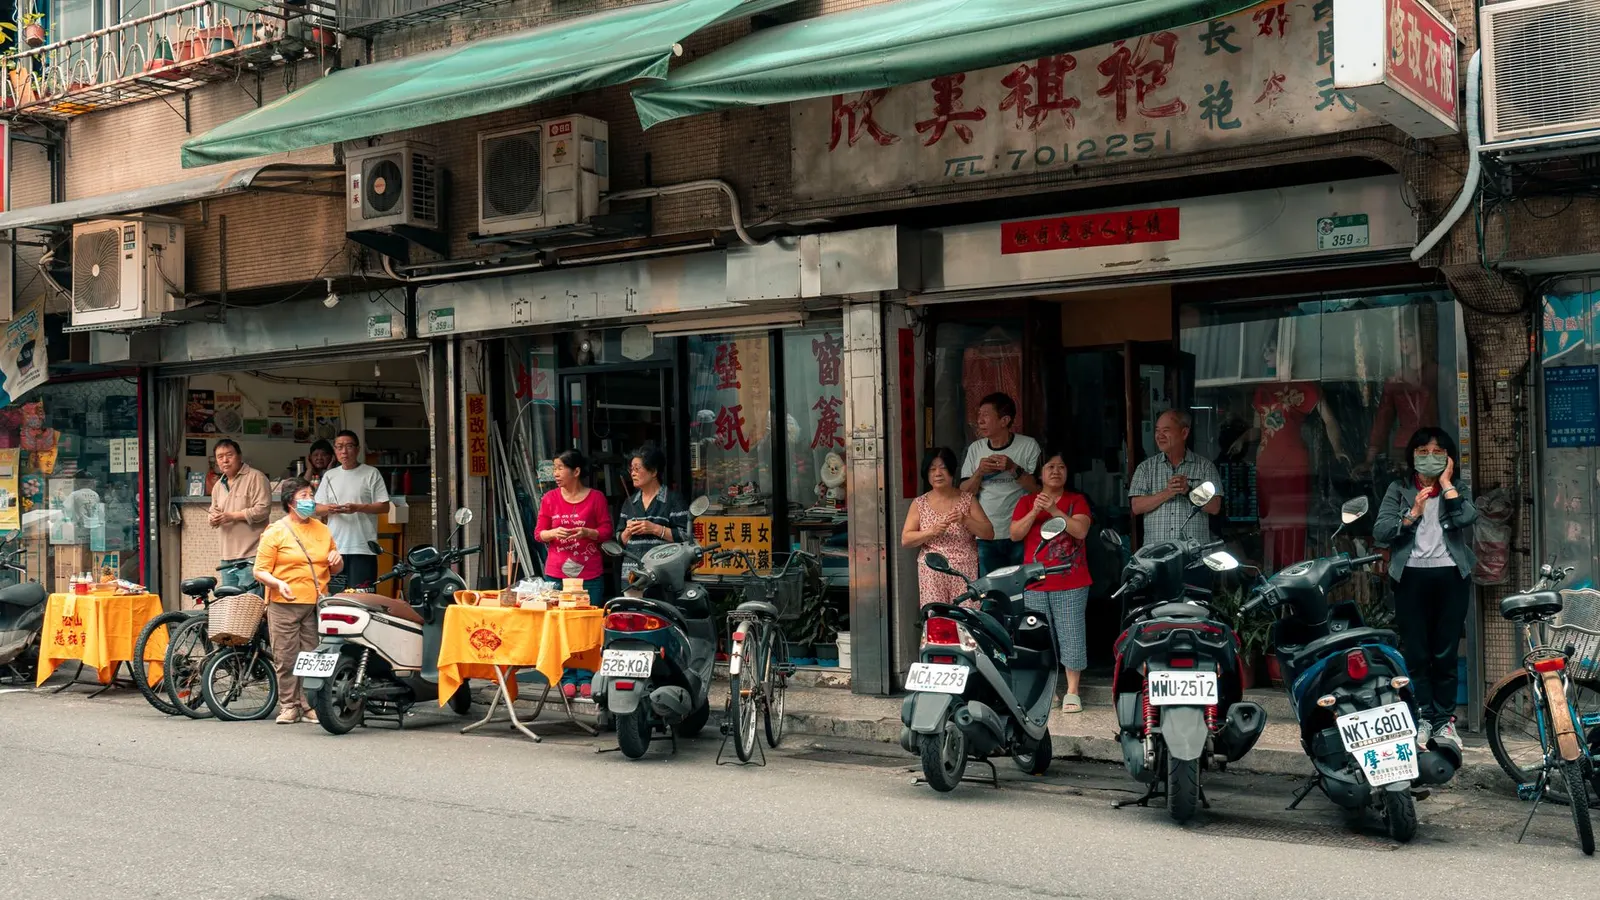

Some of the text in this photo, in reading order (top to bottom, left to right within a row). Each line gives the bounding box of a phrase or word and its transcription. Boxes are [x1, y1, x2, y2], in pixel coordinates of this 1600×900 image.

[1198, 20, 1242, 130] 長袍
[1390, 0, 1453, 104] 修改衣服
[1007, 129, 1171, 171] 7012251
[1332, 233, 1354, 246] 359
[515, 355, 549, 399] 地
[712, 342, 749, 453] 壁紙
[469, 397, 486, 472] 修改衣服
[708, 522, 769, 543] 各式男女
